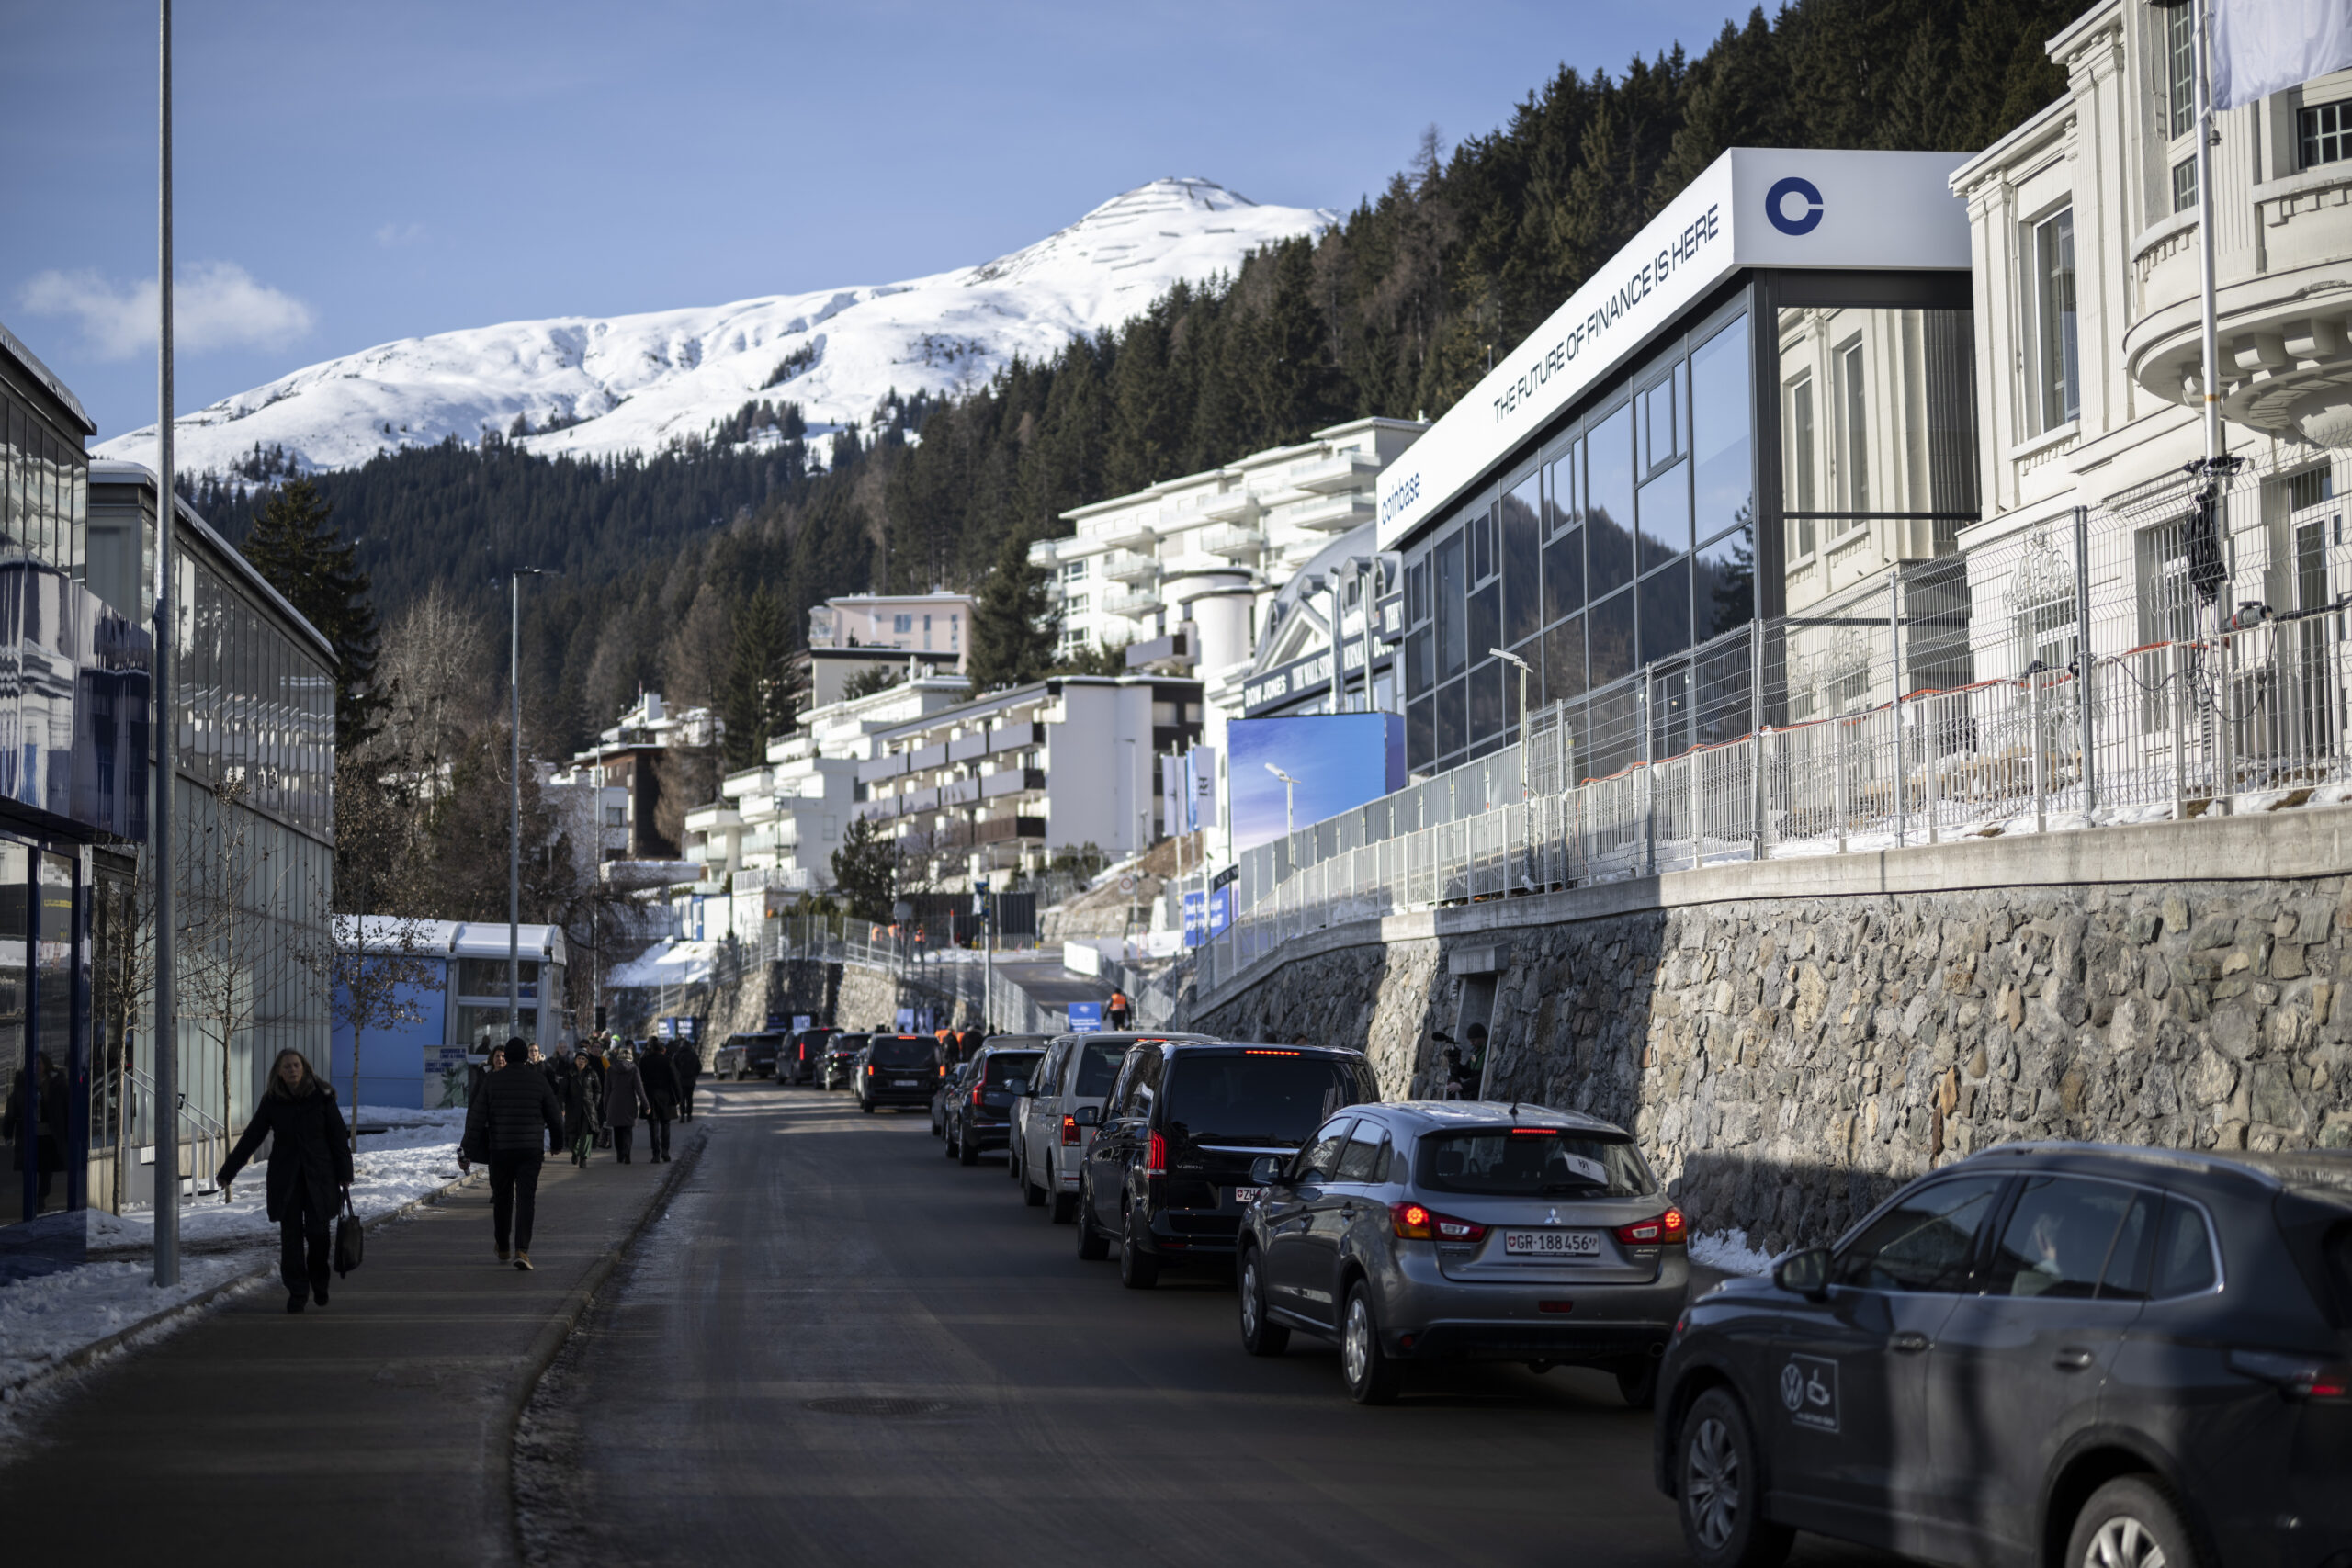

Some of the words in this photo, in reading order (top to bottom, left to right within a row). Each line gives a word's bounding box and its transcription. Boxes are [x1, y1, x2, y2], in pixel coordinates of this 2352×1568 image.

[1493, 385, 1516, 423] THE
[1518, 342, 1565, 405] FUTURE
[1566, 323, 1585, 361] OF
[1587, 263, 1652, 345] FINANCE
[1654, 250, 1669, 287] IS
[1672, 203, 1719, 271] HERE
[1382, 472, 1420, 525] coinbase
[1245, 683, 1262, 708] DOW
[1263, 674, 1286, 702] JONES
